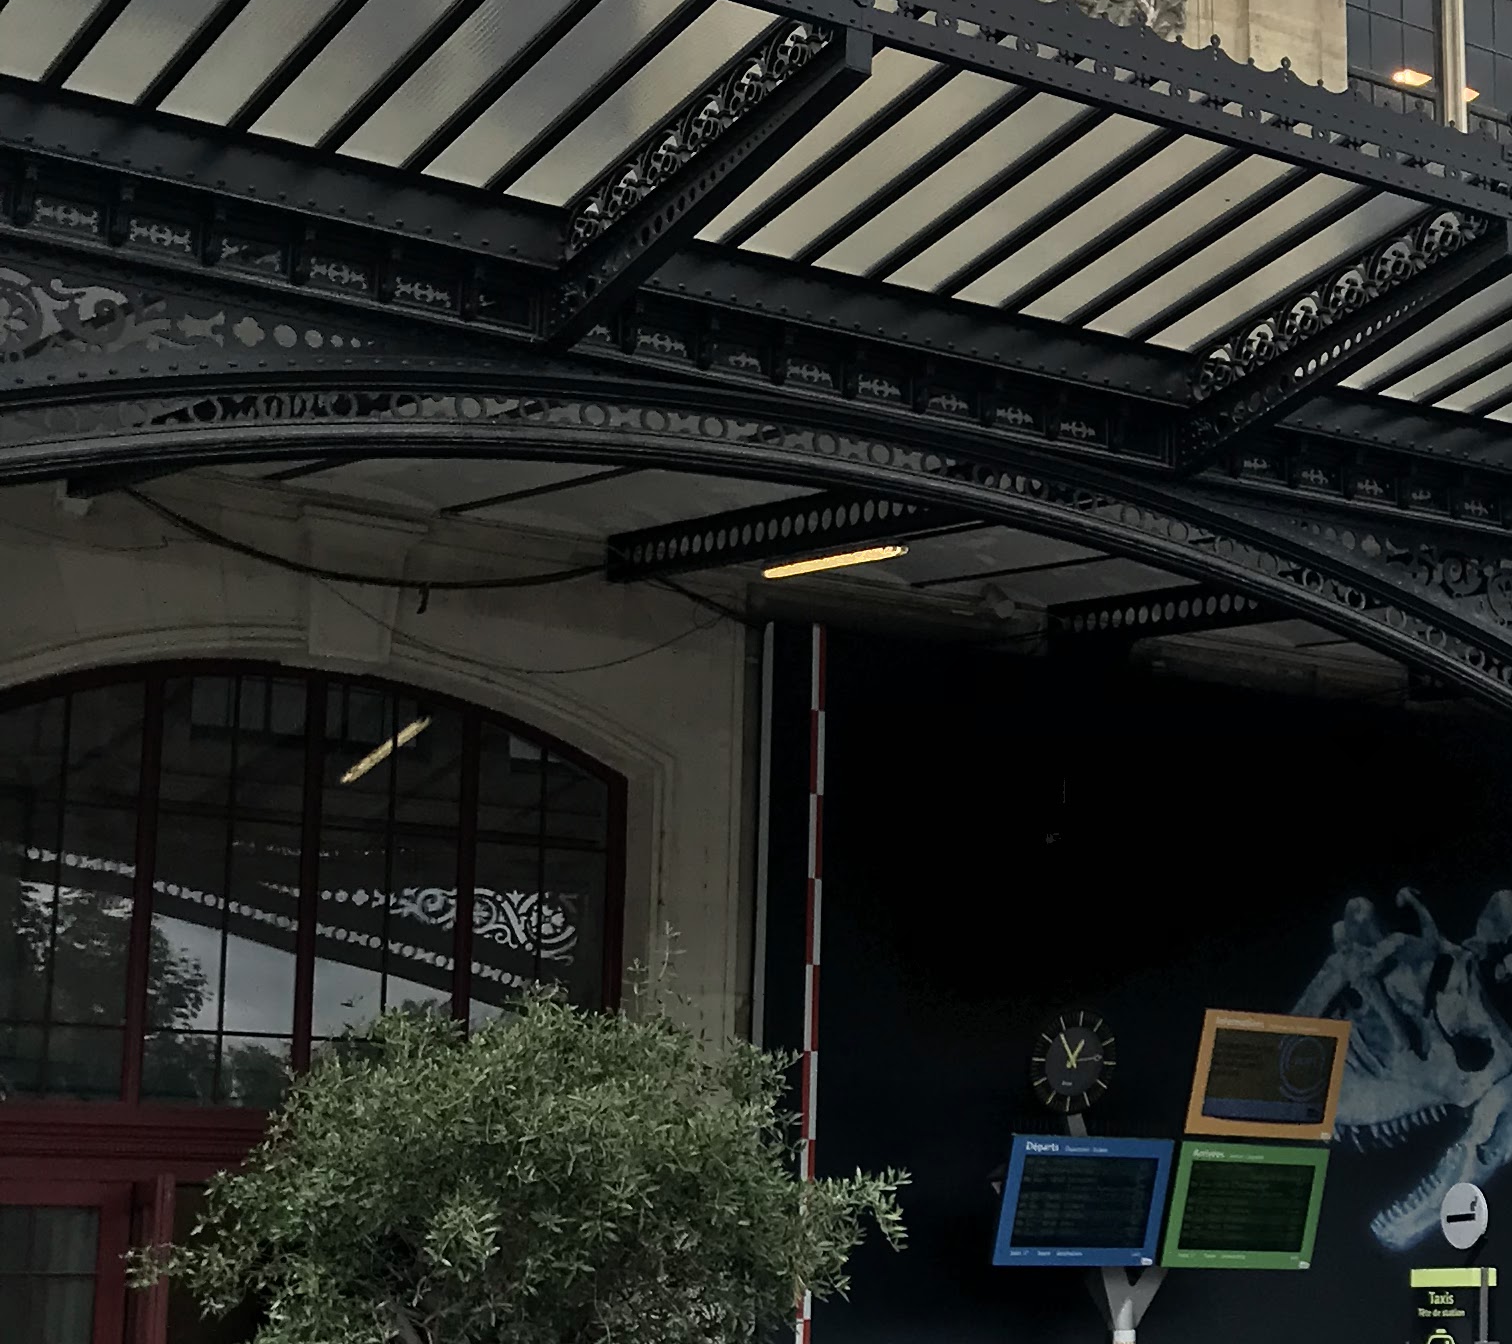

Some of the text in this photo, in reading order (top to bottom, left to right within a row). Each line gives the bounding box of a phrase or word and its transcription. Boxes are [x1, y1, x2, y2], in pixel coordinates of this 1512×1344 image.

[1026, 1141, 1059, 1152] Départs
[1428, 1291, 1454, 1304] Taxis
[1432, 1308, 1441, 1317] de
[1442, 1308, 1466, 1317] station
